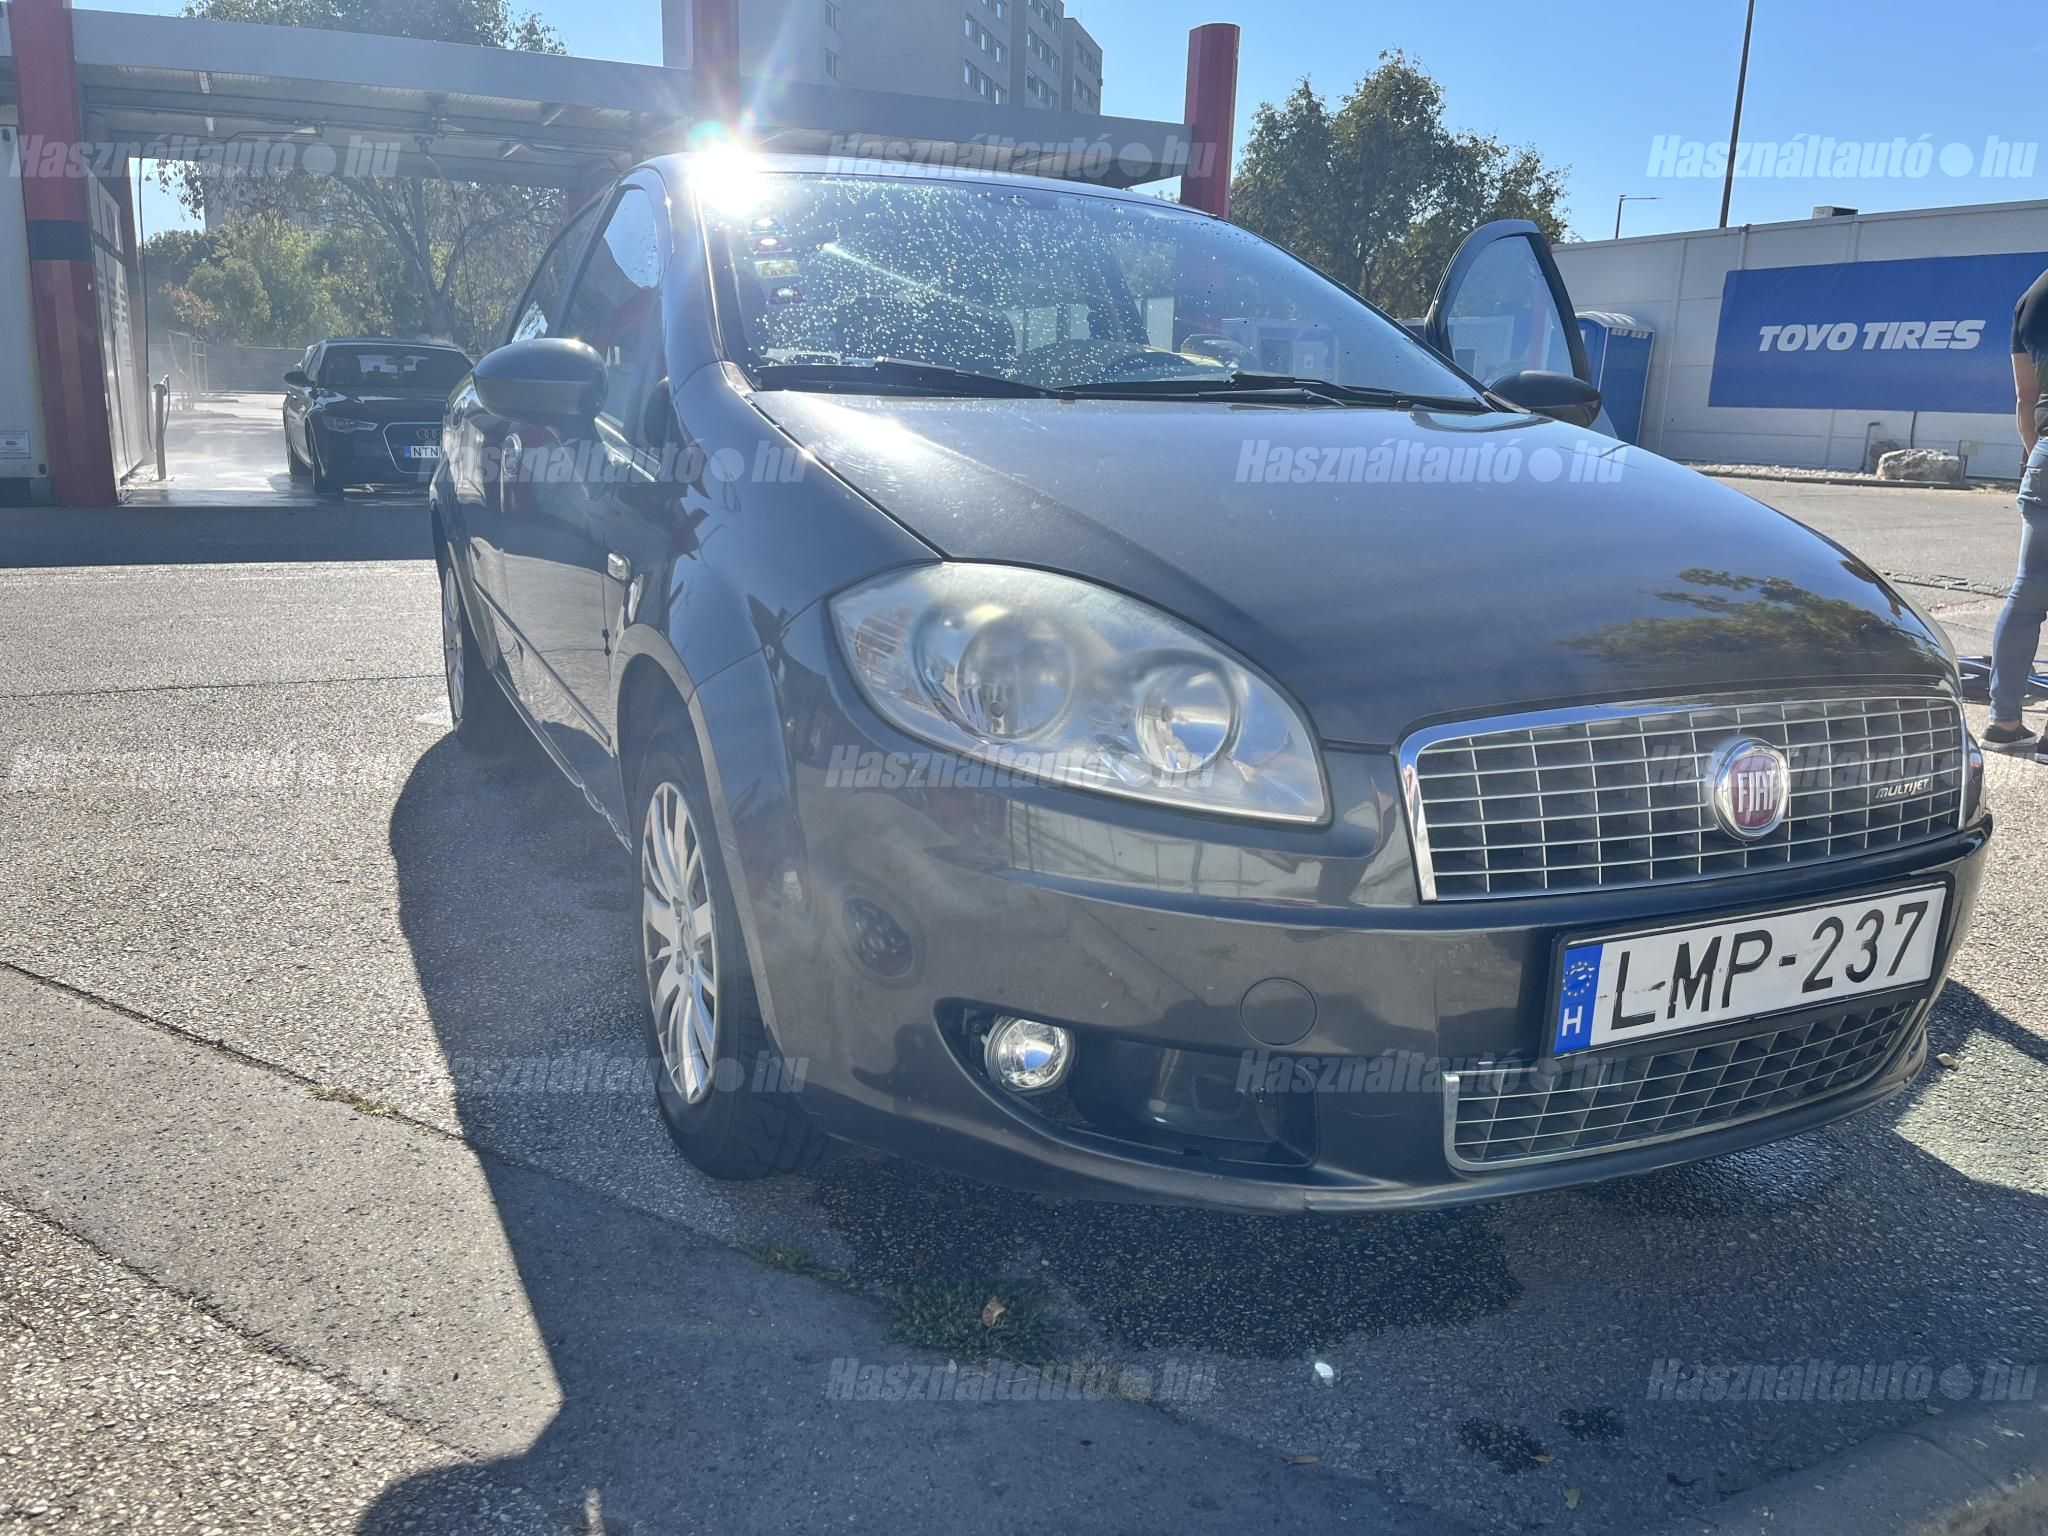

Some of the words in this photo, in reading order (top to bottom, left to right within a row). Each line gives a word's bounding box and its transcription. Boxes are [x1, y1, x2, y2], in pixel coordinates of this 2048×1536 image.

[1759, 322, 1858, 352] TOYO
[1862, 320, 1986, 350] TIRES
[1737, 770, 1776, 813] FIAT
[1875, 778, 1930, 800] MULTIJET
[1611, 900, 1929, 1031] LMP-237
[1561, 1004, 1583, 1038] H
